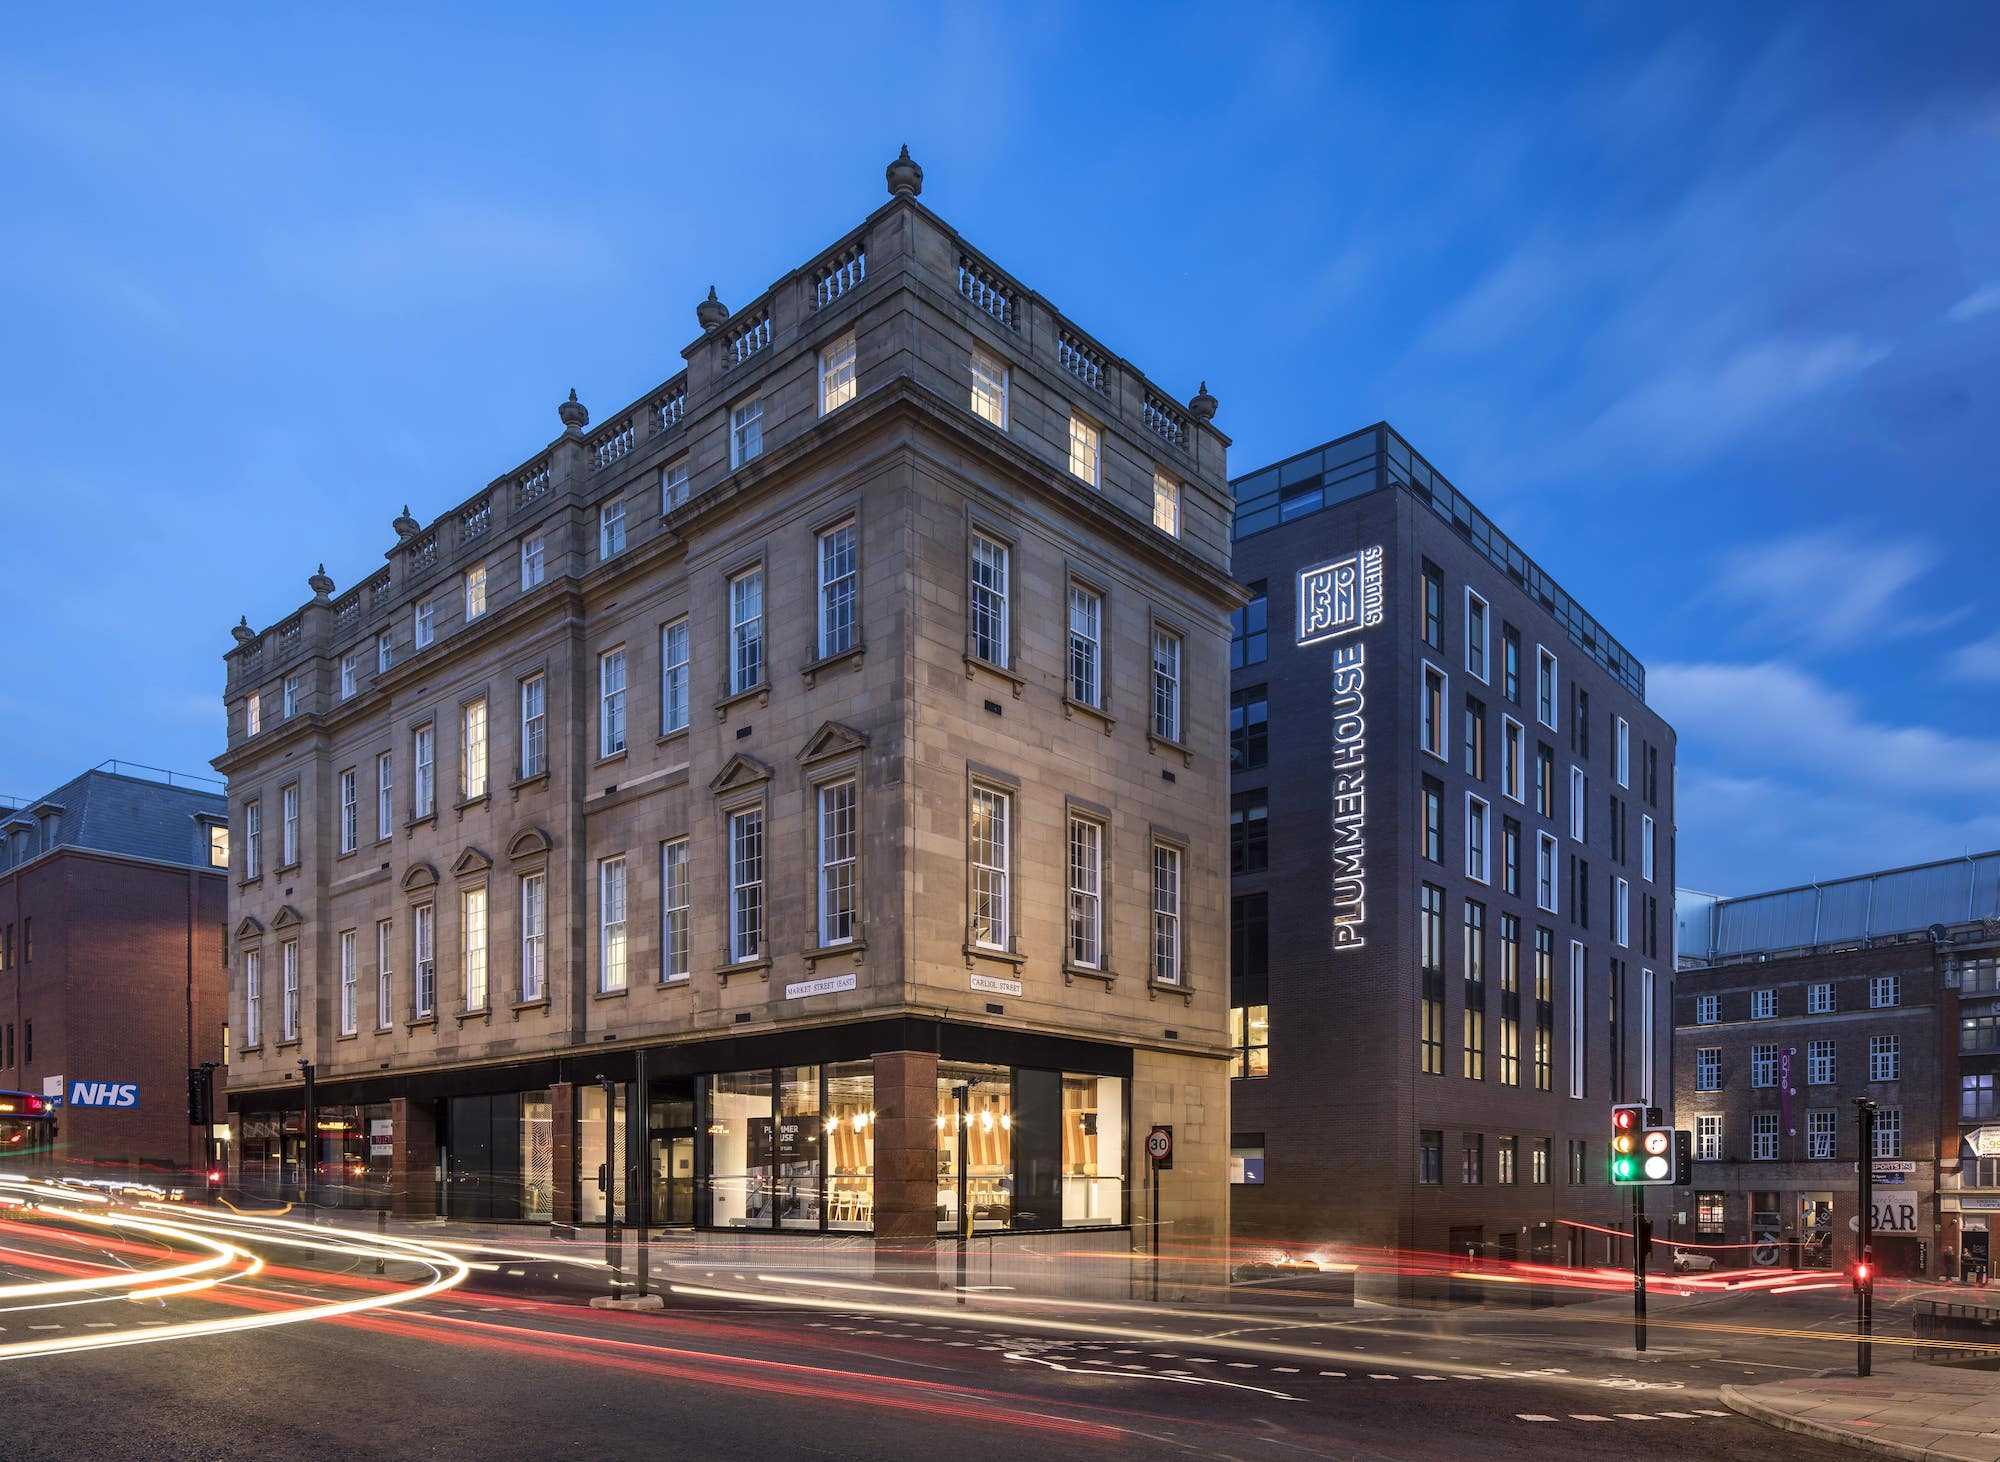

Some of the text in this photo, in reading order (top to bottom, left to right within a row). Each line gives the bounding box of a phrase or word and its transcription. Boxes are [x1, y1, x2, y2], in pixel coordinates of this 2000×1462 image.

[1364, 544, 1384, 626] STUDENTS
[1333, 643, 1365, 950] PLUMMER HOUSE
[787, 984, 812, 995] MARKET
[813, 981, 834, 991] STREET
[999, 982, 1021, 993] STREET
[71, 1082, 137, 1107] NHS
[1150, 1138, 1167, 1150] 30
